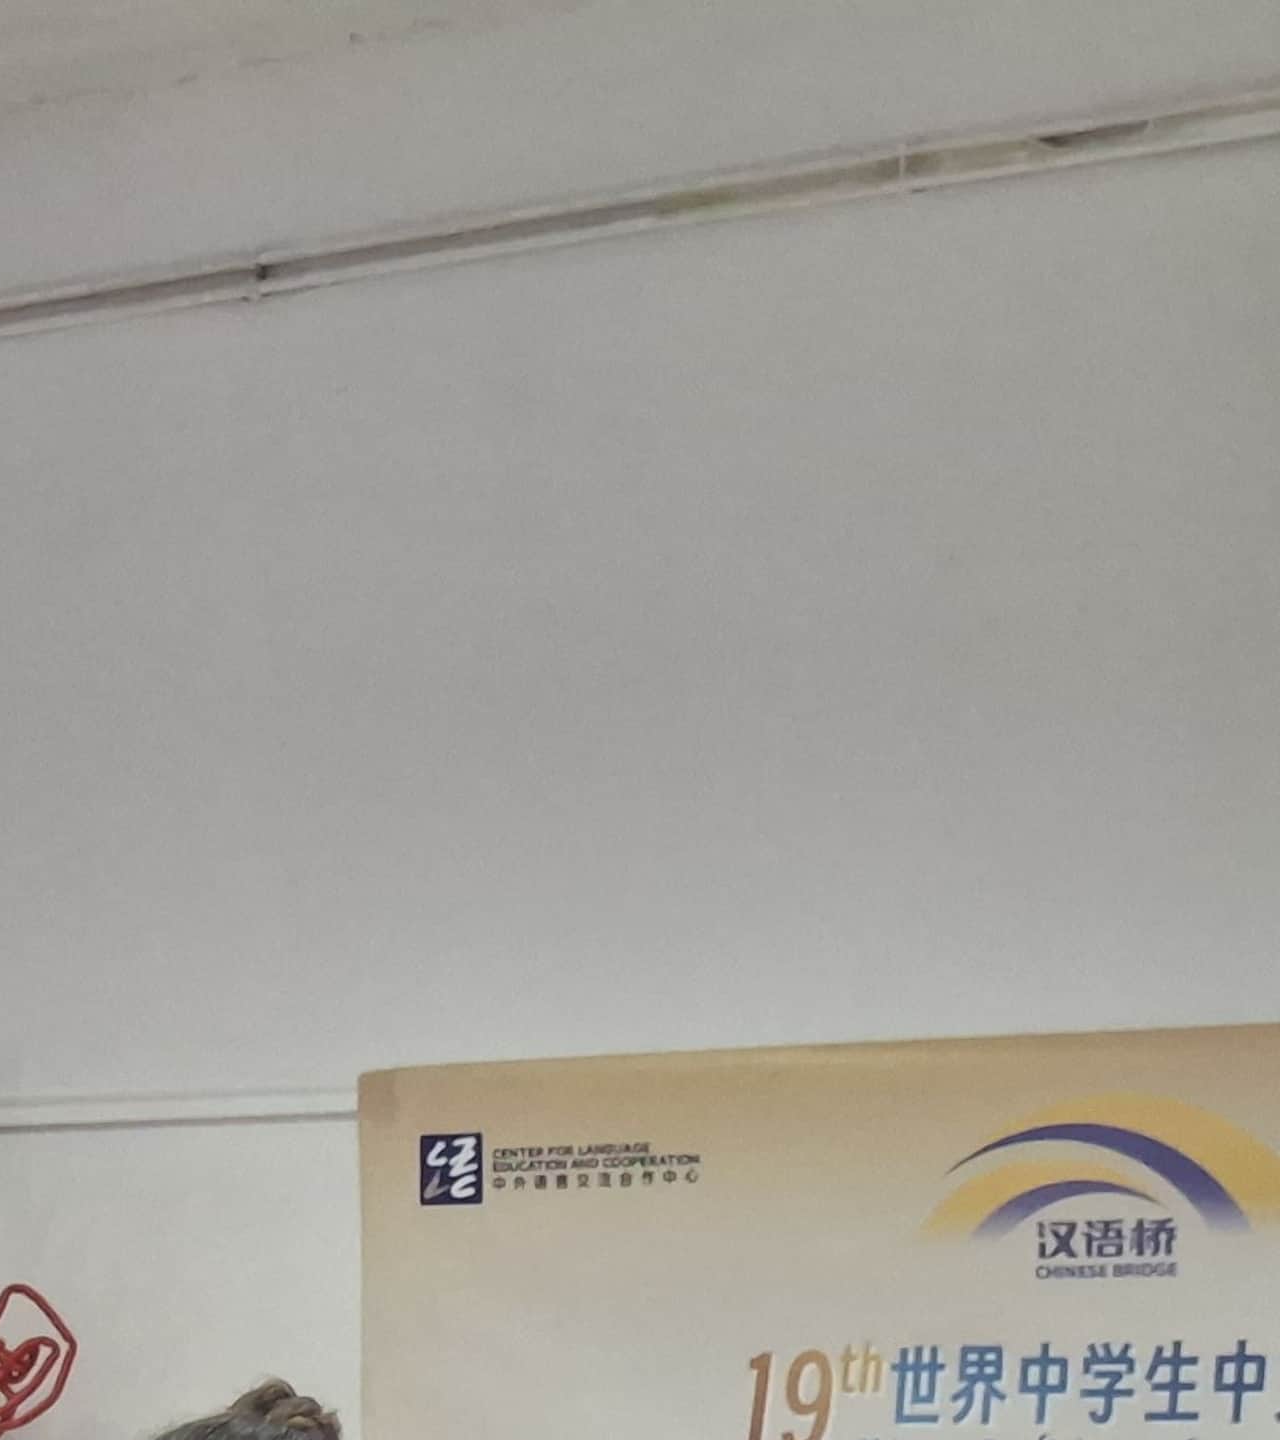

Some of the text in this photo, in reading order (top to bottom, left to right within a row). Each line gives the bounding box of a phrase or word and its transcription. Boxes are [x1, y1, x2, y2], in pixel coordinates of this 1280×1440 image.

[493, 1147, 544, 1160] CENTER
[577, 1142, 651, 1156] LANGUAGE
[493, 1159, 568, 1173] EDUCATION
[603, 1154, 701, 1168] COOPERATION
[1037, 1217, 1177, 1259] 汉语桥
[1035, 1262, 1178, 1279] CHINESE BRIDGE
[890, 1339, 1279, 1426] 世界中学生中
